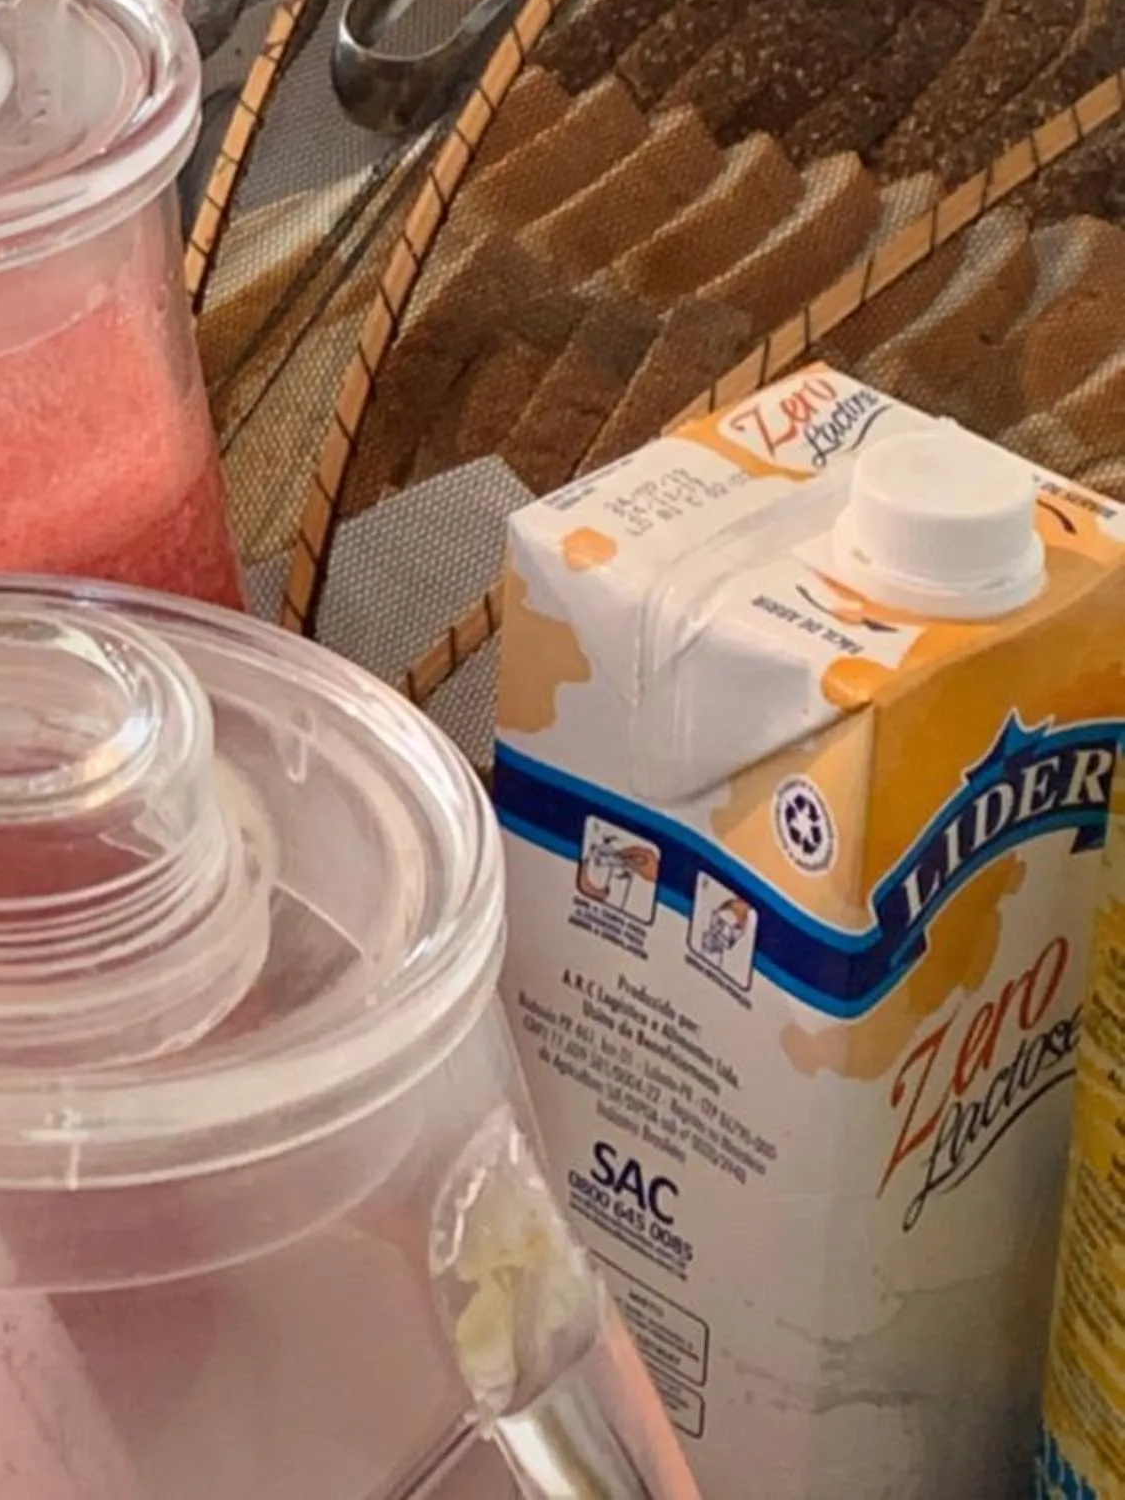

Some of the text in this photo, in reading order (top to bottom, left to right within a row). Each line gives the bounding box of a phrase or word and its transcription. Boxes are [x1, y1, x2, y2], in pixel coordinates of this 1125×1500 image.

[876, 936, 1069, 1200] Zero
[568, 1169, 610, 1209] 0800
[590, 1140, 679, 1225] SAC
